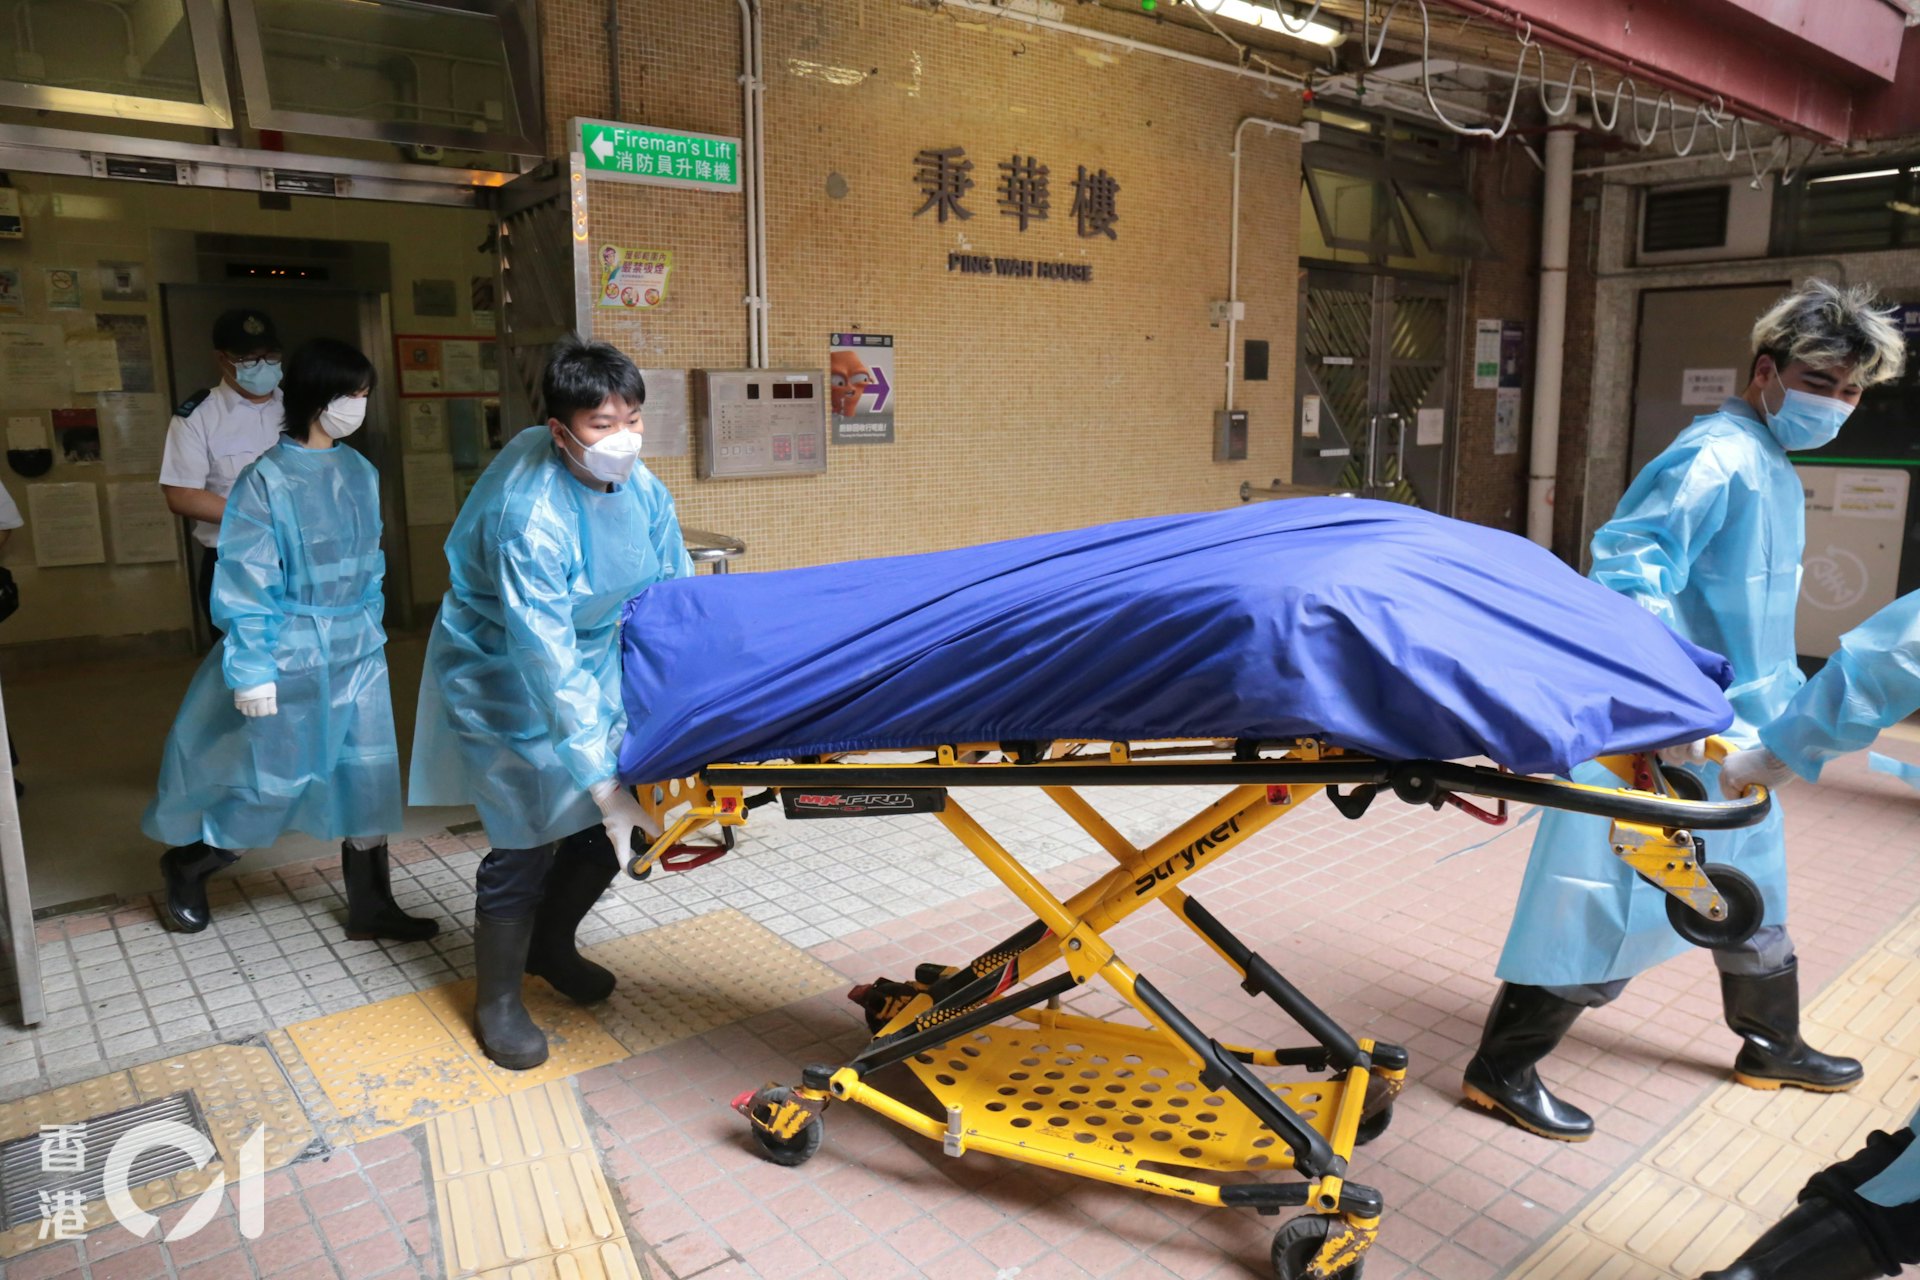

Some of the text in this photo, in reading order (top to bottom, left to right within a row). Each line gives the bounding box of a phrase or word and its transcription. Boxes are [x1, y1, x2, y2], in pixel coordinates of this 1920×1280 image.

[613, 129, 732, 160] Fireman's Lift
[615, 150, 732, 182] 消防員升降機
[912, 146, 1121, 241] 秉華樓
[947, 252, 1094, 283] PING WAH HOUSE
[799, 793, 908, 807] MX-PRO
